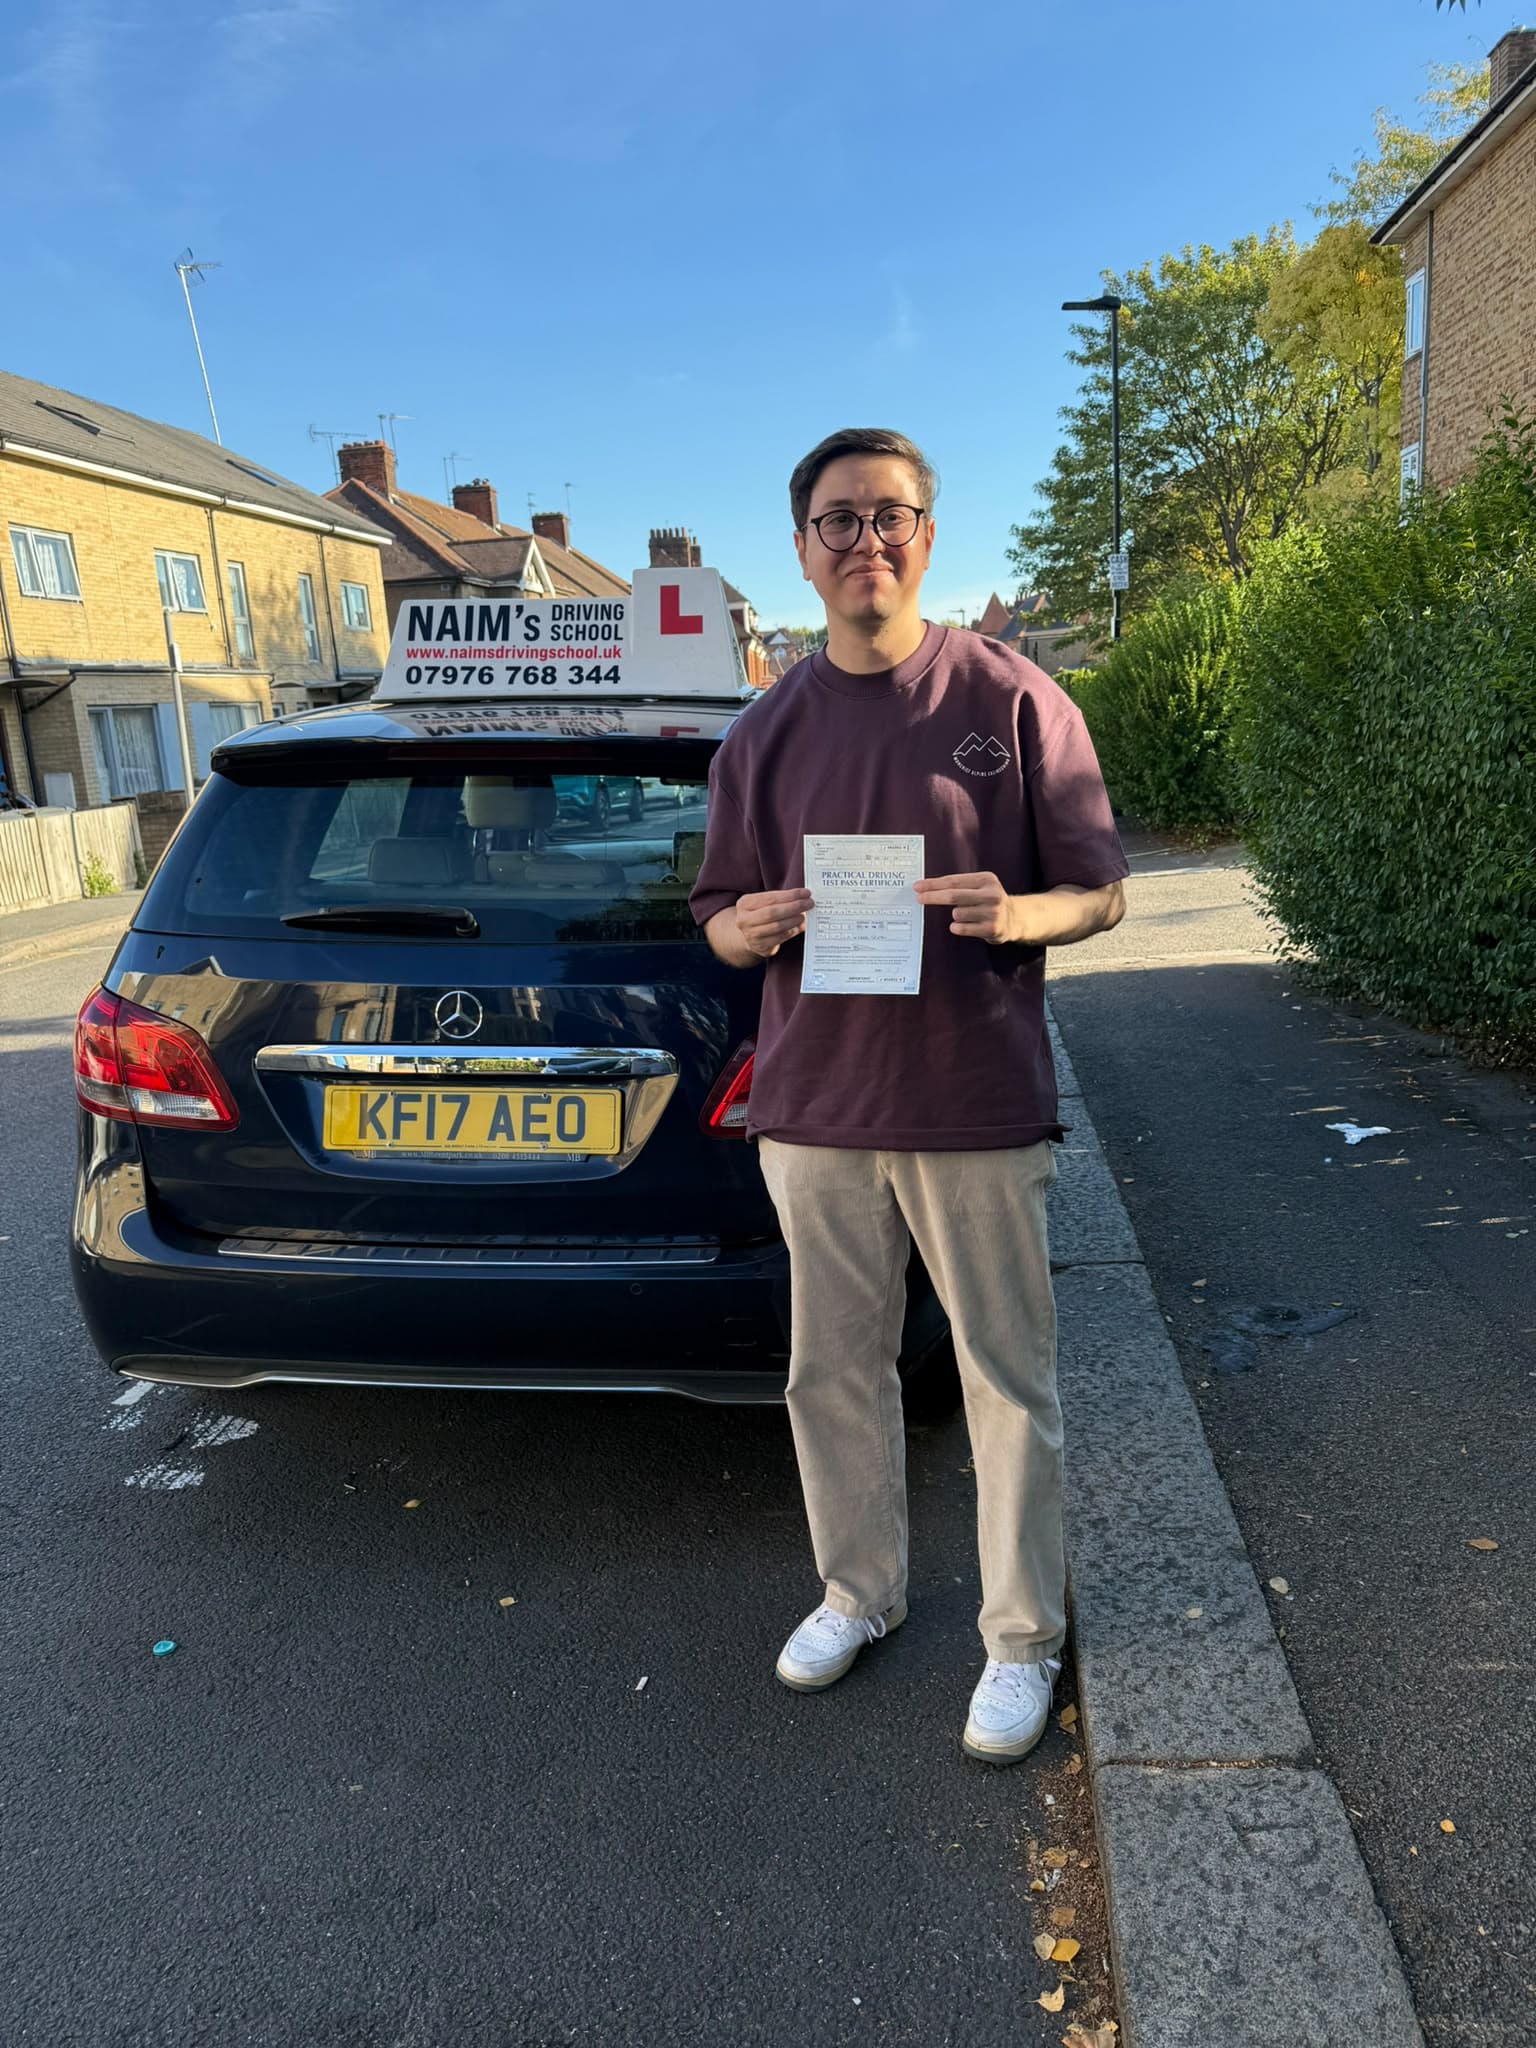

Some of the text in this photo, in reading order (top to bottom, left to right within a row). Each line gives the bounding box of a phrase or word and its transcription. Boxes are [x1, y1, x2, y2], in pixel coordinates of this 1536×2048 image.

[659, 584, 704, 635] L
[407, 603, 625, 642] NAIM's DRIVING
[550, 623, 624, 641] SCHOOL
[406, 645, 623, 661] www.naimsdrivingschool.uk
[405, 665, 622, 685] 07976 768 344
[822, 871, 905, 879] PRACTICAL DRIVING
[822, 879, 905, 887] TEST PASS CERTIFICATE
[357, 1092, 587, 1143] KF17 AEO
